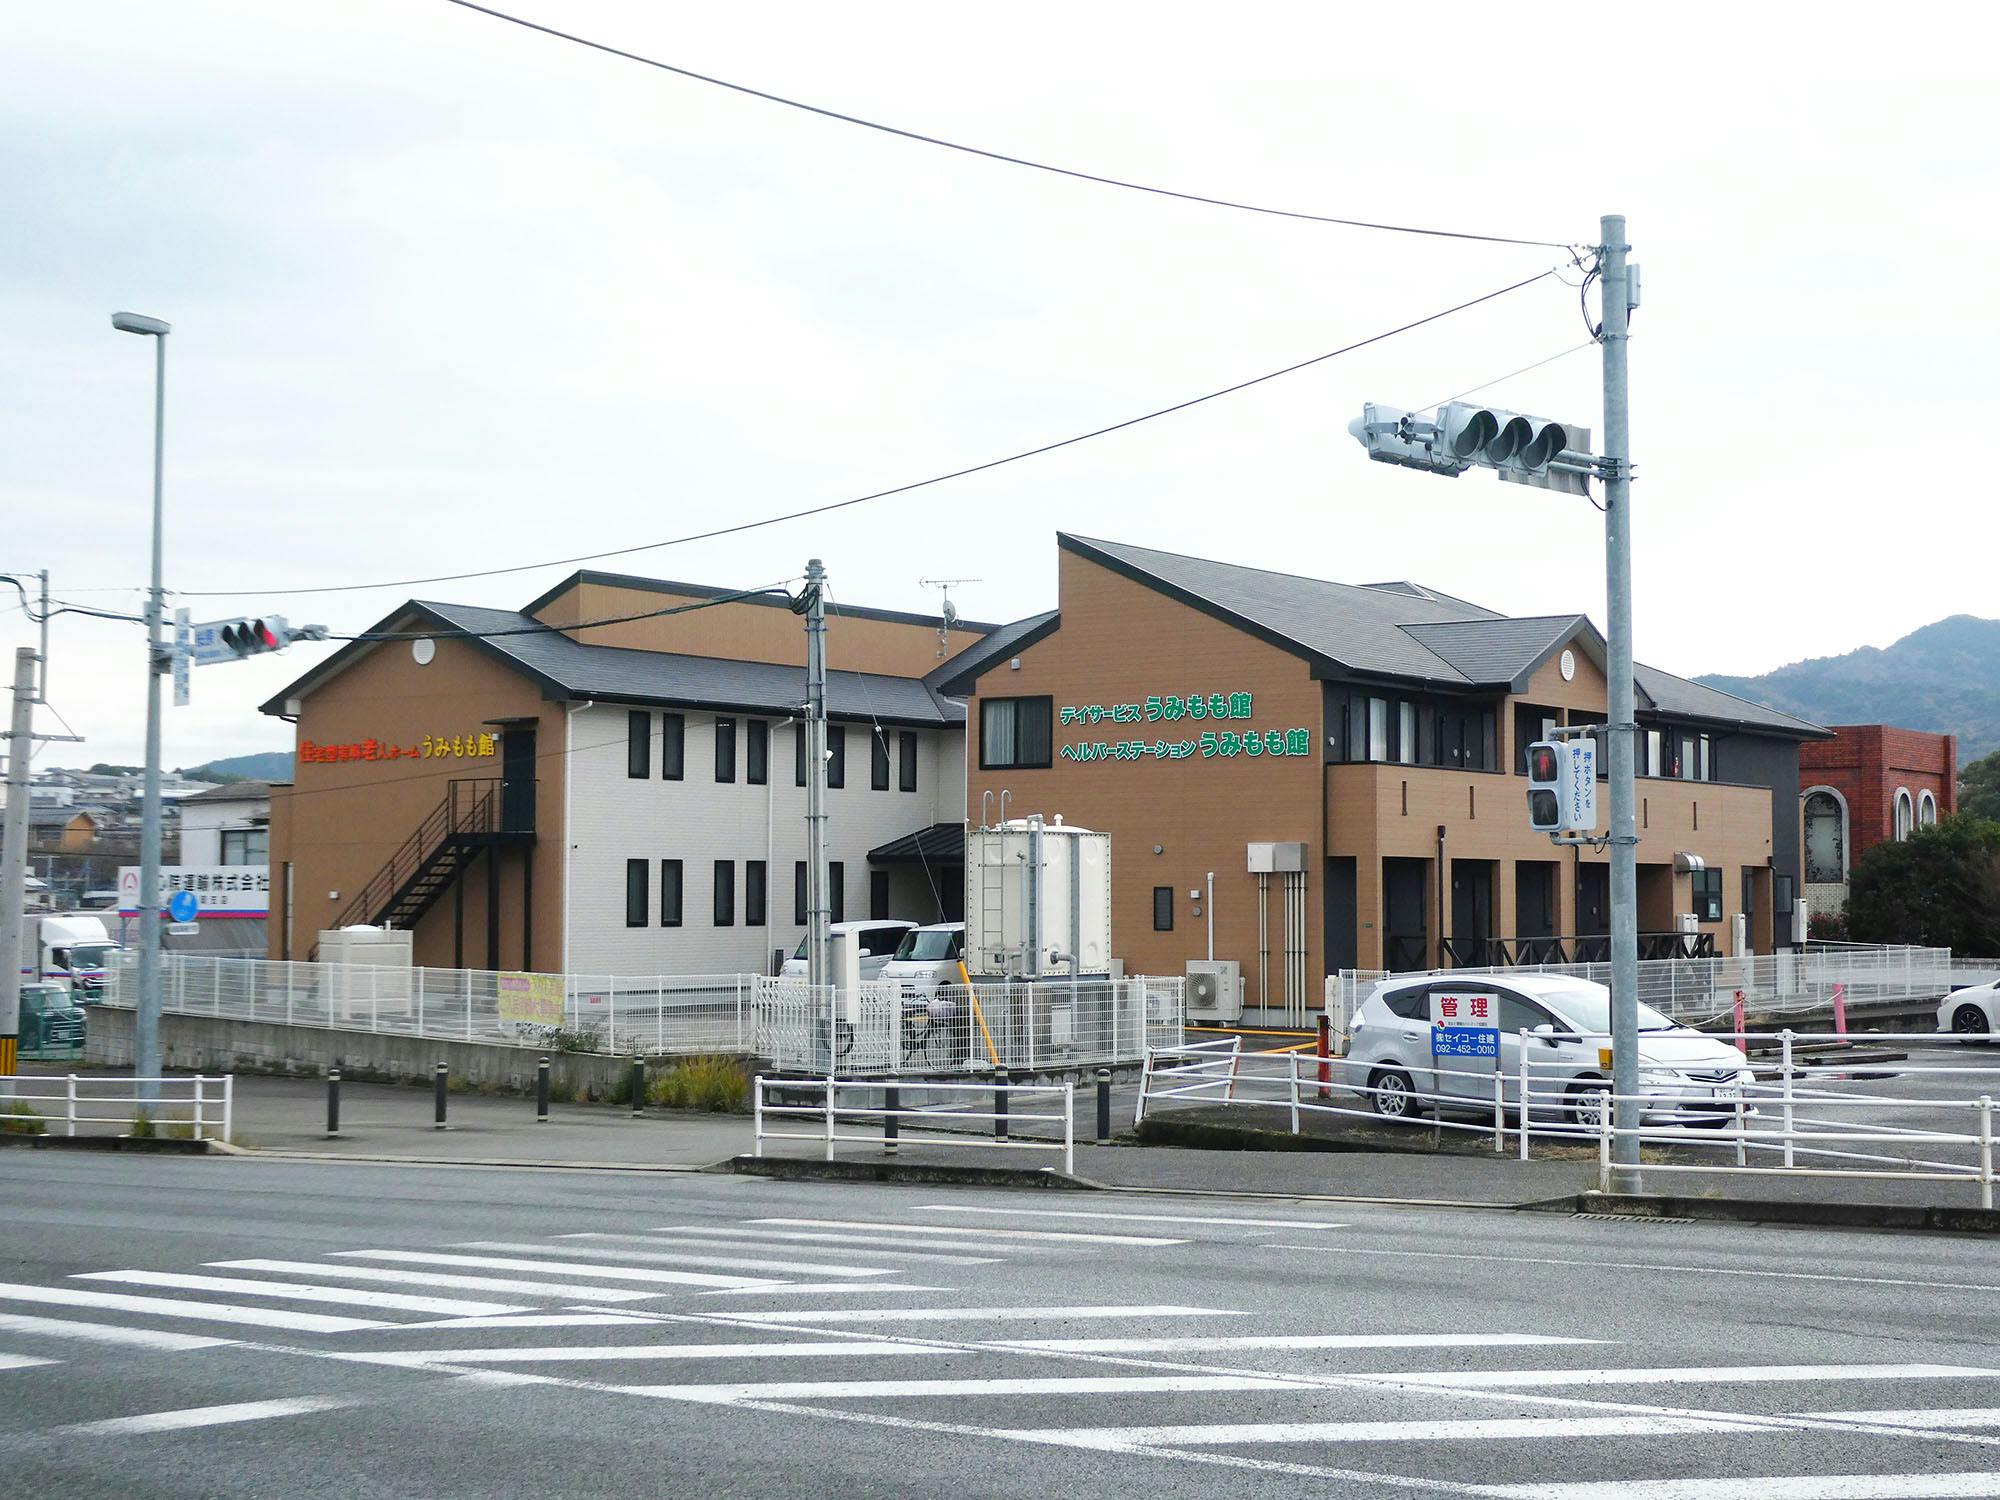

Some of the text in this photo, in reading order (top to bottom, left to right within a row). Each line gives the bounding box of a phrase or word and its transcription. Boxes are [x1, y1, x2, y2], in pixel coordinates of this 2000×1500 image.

[1061, 692, 1252, 725] デイサービス うみもも館
[423, 733, 495, 758] うみもも館
[1200, 728, 1309, 756] うみもも館
[1572, 747, 1582, 822] 押してください
[1441, 997, 1488, 1017] 管理
[1436, 1044, 1495, 1055] 092-452-0010
